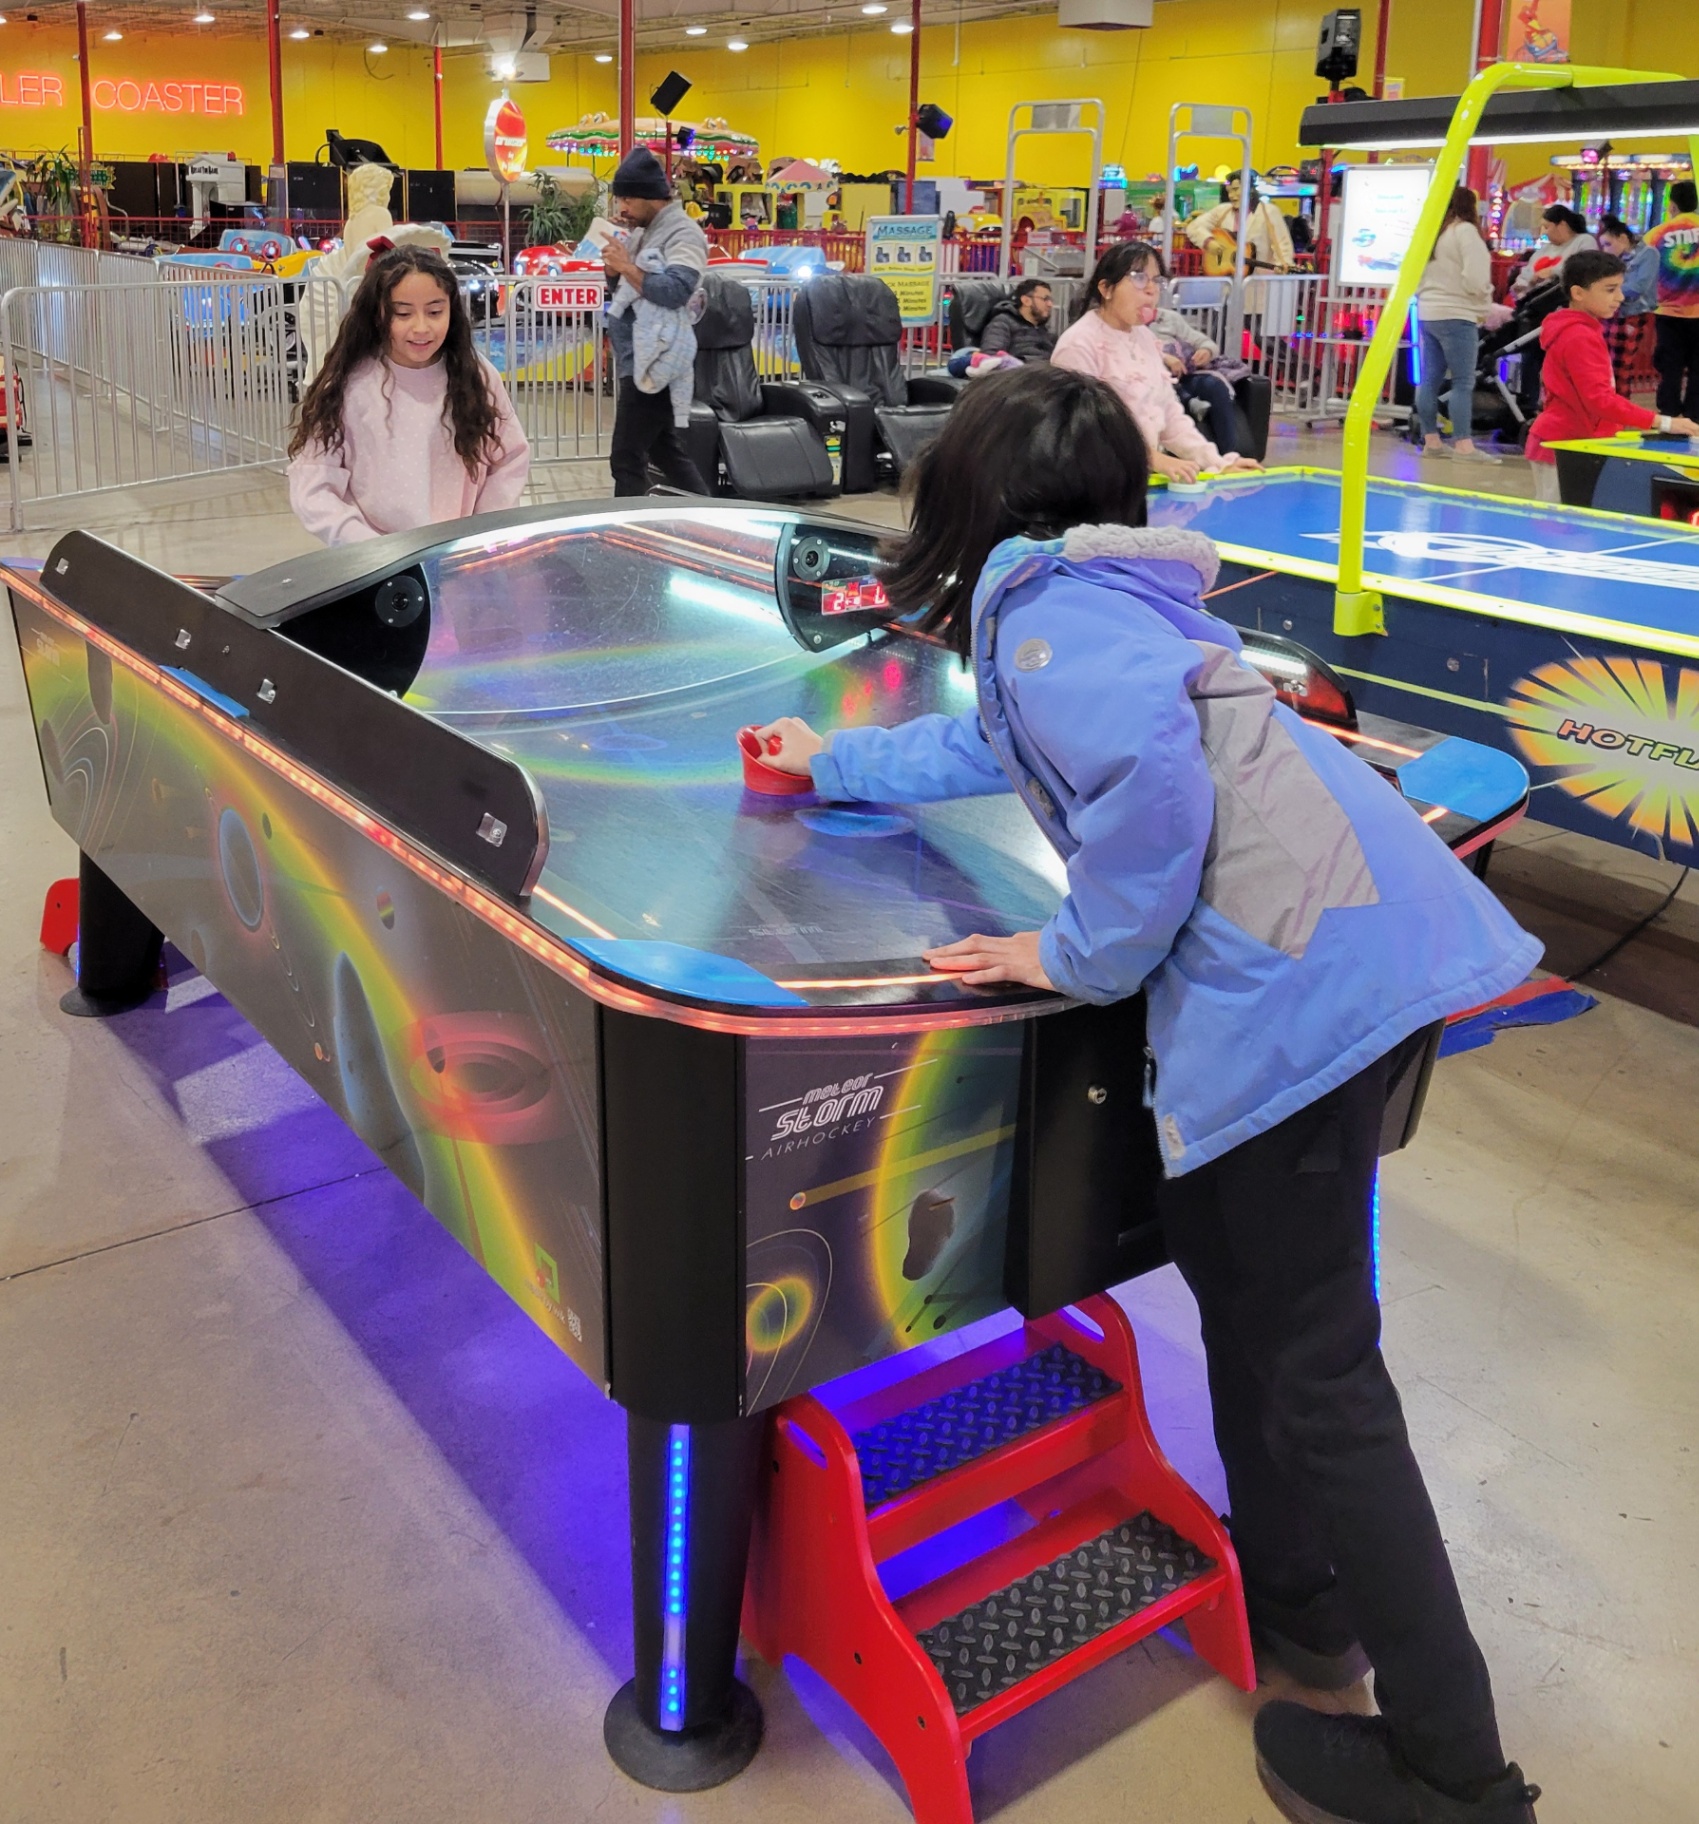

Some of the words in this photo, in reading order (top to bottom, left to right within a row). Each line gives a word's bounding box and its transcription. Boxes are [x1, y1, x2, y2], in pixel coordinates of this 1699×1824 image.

[92, 80, 244, 115] COASTER
[877, 225, 933, 236] MASSAGE
[540, 288, 598, 305] ENTER
[1557, 718, 1699, 771] HOTFL
[802, 1072, 874, 1106] meteor
[770, 1086, 884, 1141] storm
[760, 1116, 876, 1161] AIRHOCKEY
